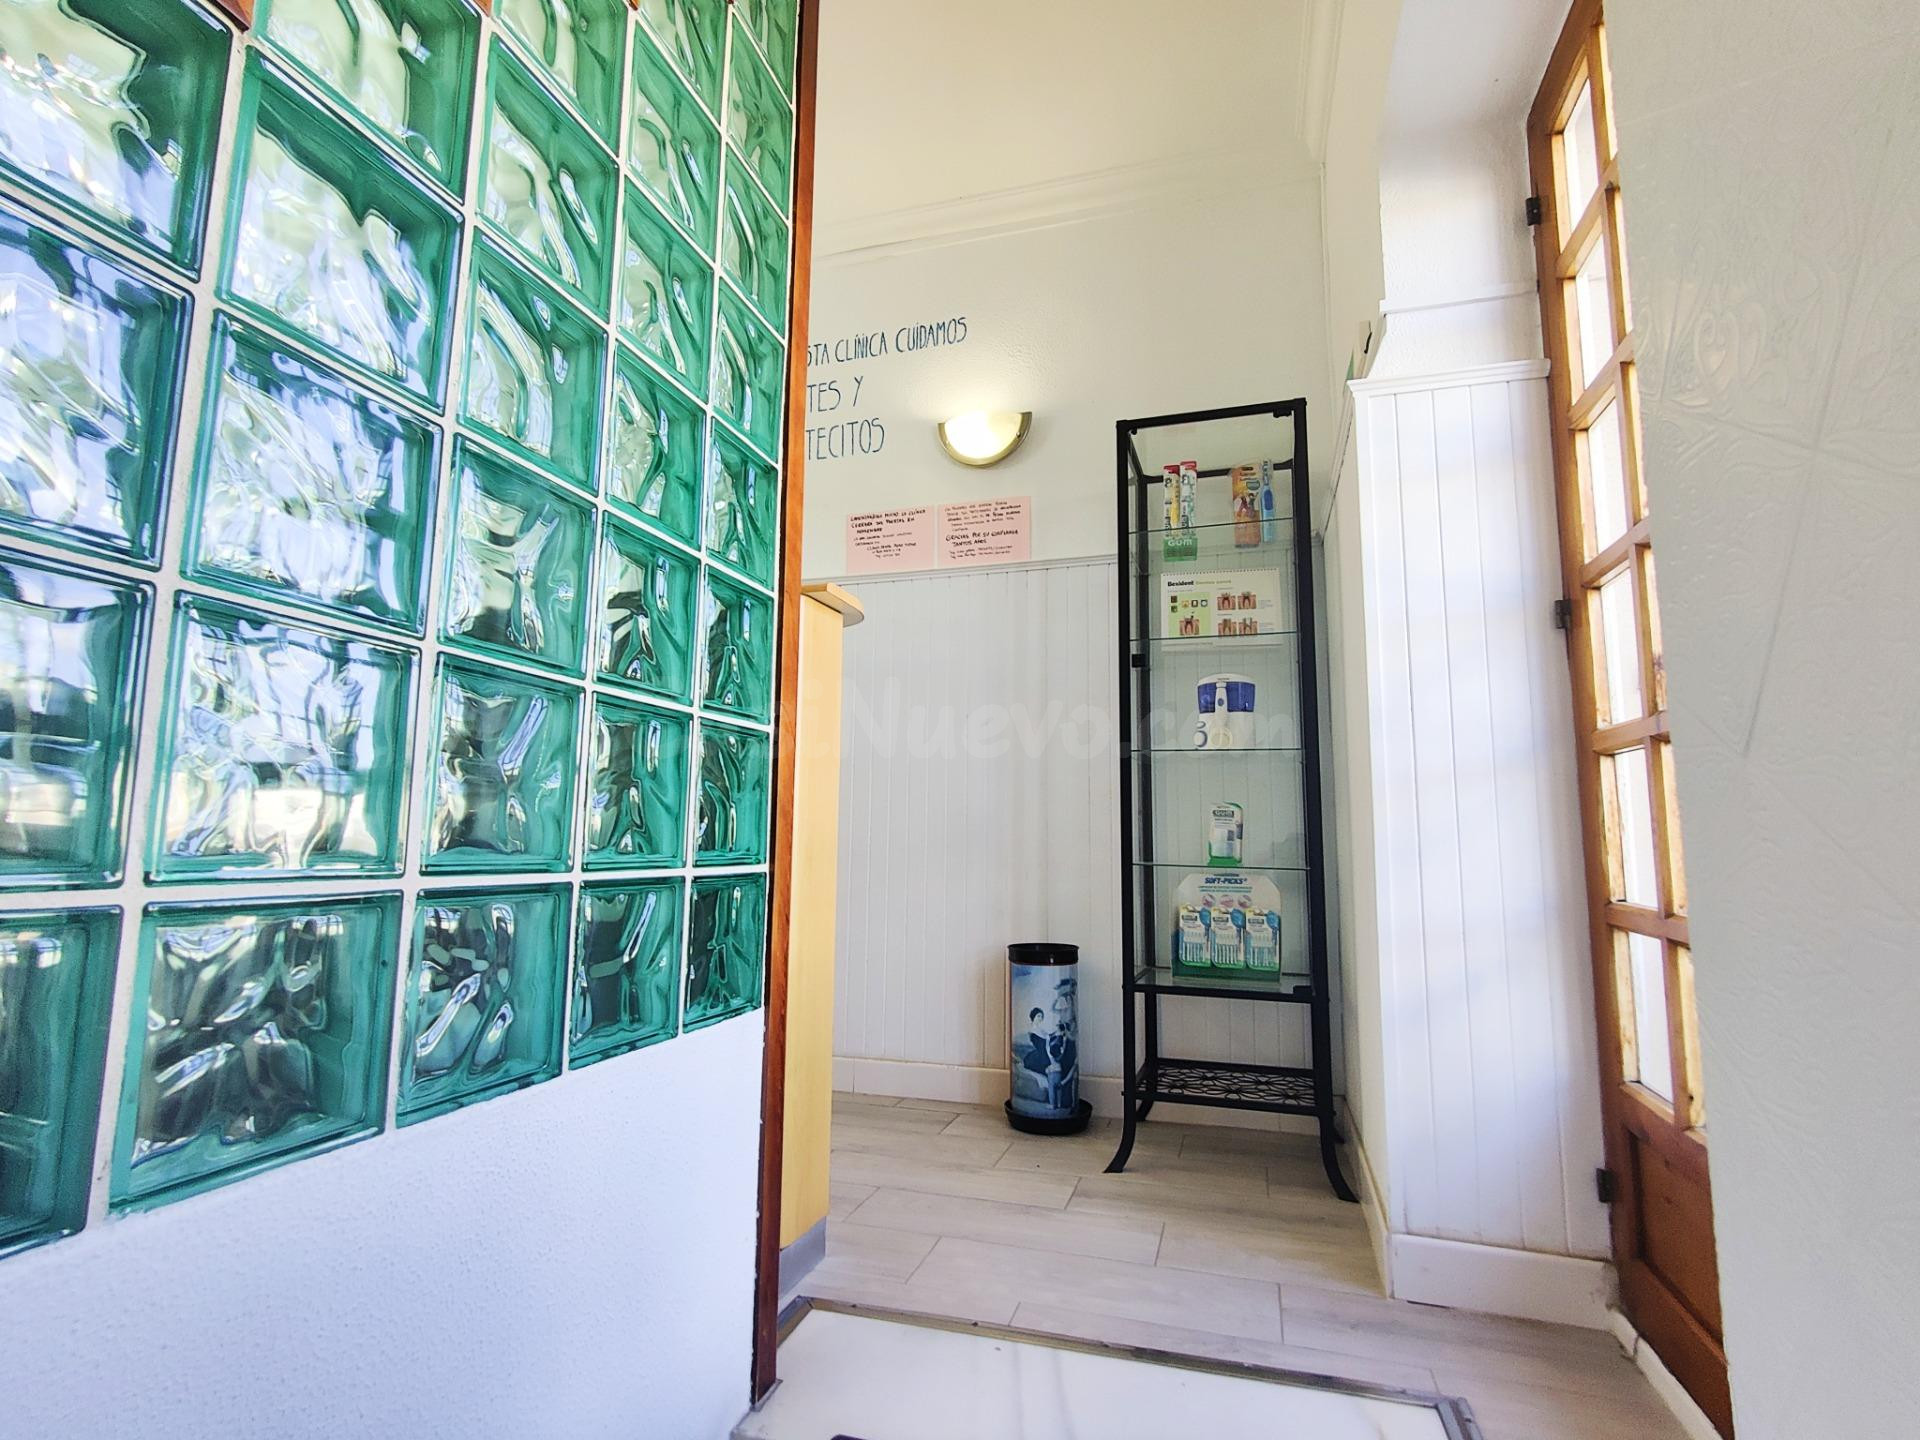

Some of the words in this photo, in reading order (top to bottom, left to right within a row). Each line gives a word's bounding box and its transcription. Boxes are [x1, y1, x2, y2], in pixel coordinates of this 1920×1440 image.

[806, 380, 841, 414] TES
[853, 375, 864, 407] Y
[805, 417, 885, 461] TECITOS
